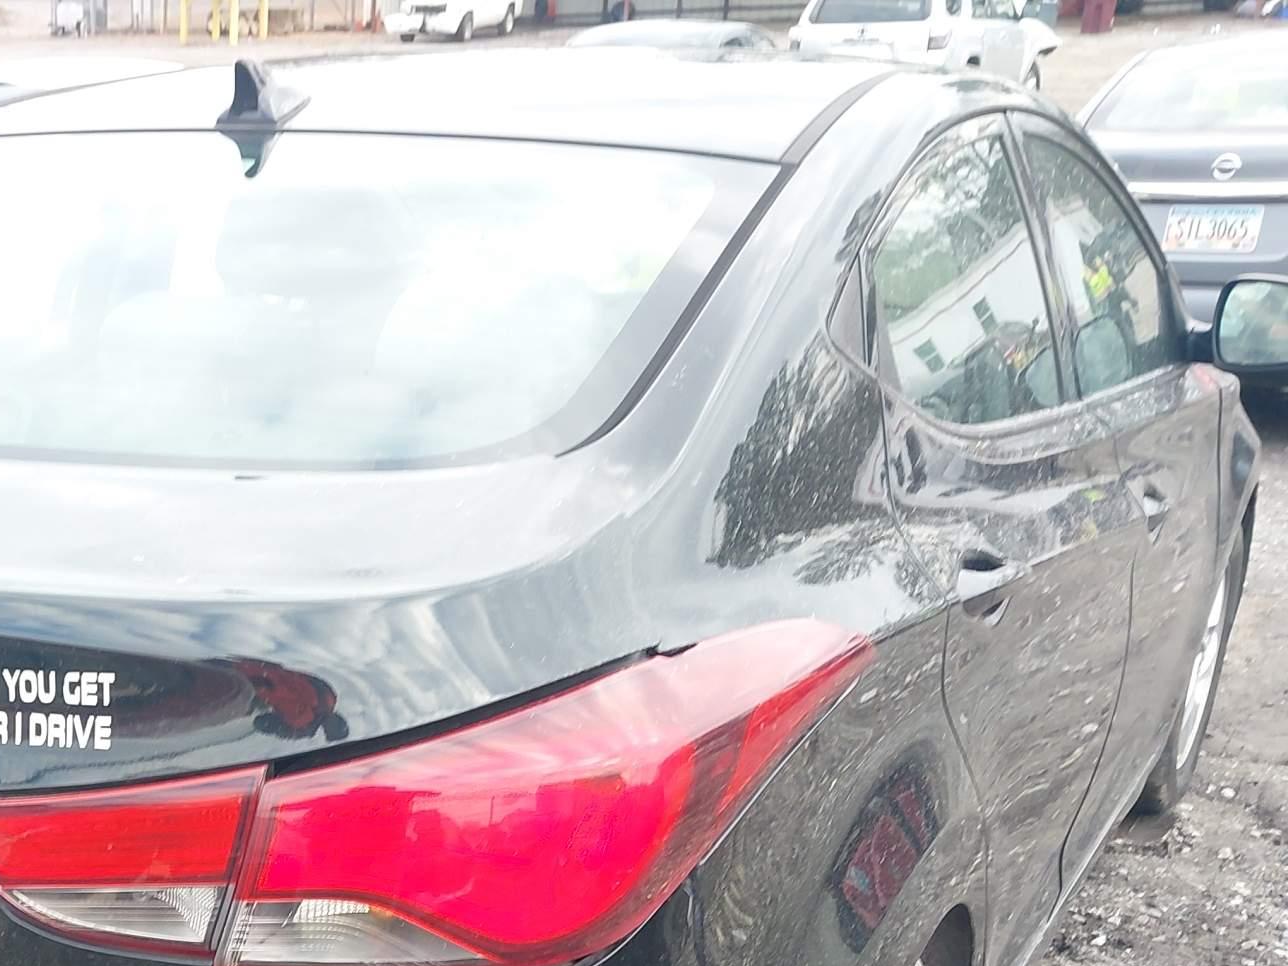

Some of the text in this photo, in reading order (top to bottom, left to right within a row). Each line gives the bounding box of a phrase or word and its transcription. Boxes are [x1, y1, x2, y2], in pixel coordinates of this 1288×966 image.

[2, 669, 56, 704] YOU
[62, 671, 116, 707] GET
[14, 711, 22, 746] I
[28, 712, 113, 751] DRIVE
